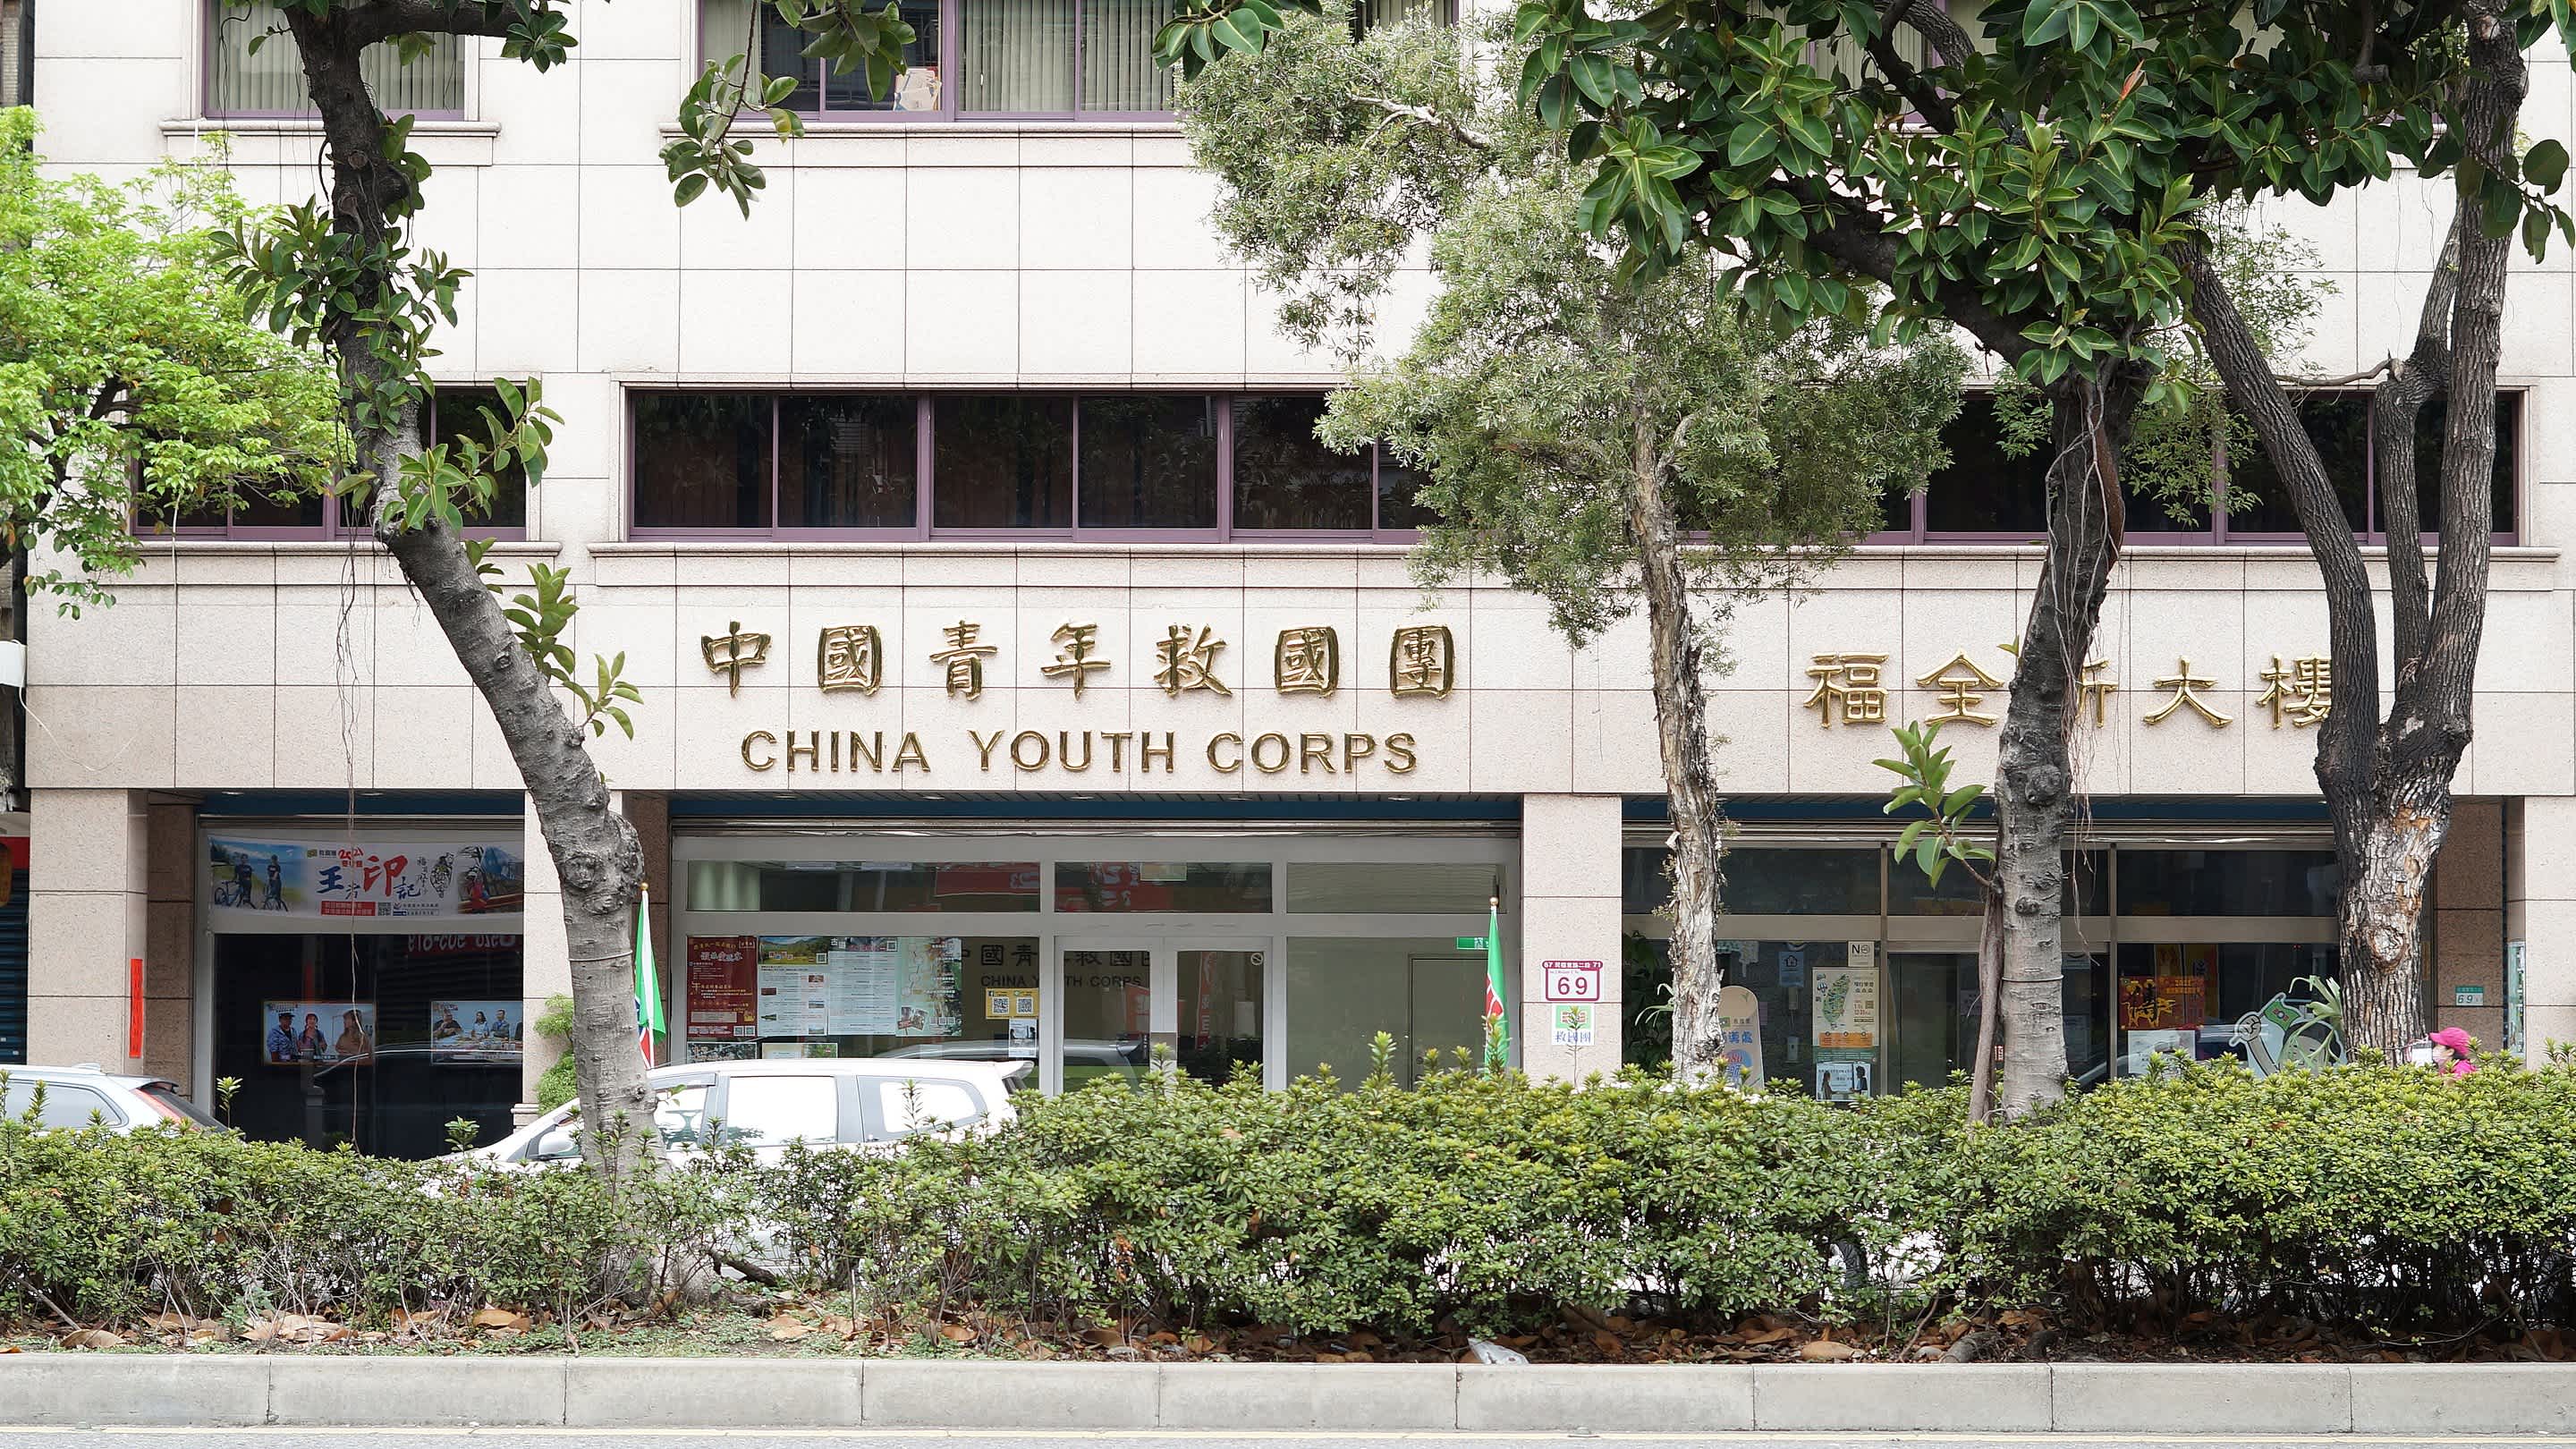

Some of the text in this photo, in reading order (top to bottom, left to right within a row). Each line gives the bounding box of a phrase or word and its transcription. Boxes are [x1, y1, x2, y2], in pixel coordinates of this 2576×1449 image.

[700, 620, 1454, 699] 中國青年救國團
[741, 730, 1419, 774] CHINA YOUTH CORPS
[980, 975, 1026, 987] CHINA
[1089, 975, 1141, 987] CORPS
[1557, 976, 1588, 996] 69
[2458, 994, 2473, 1004] 69
